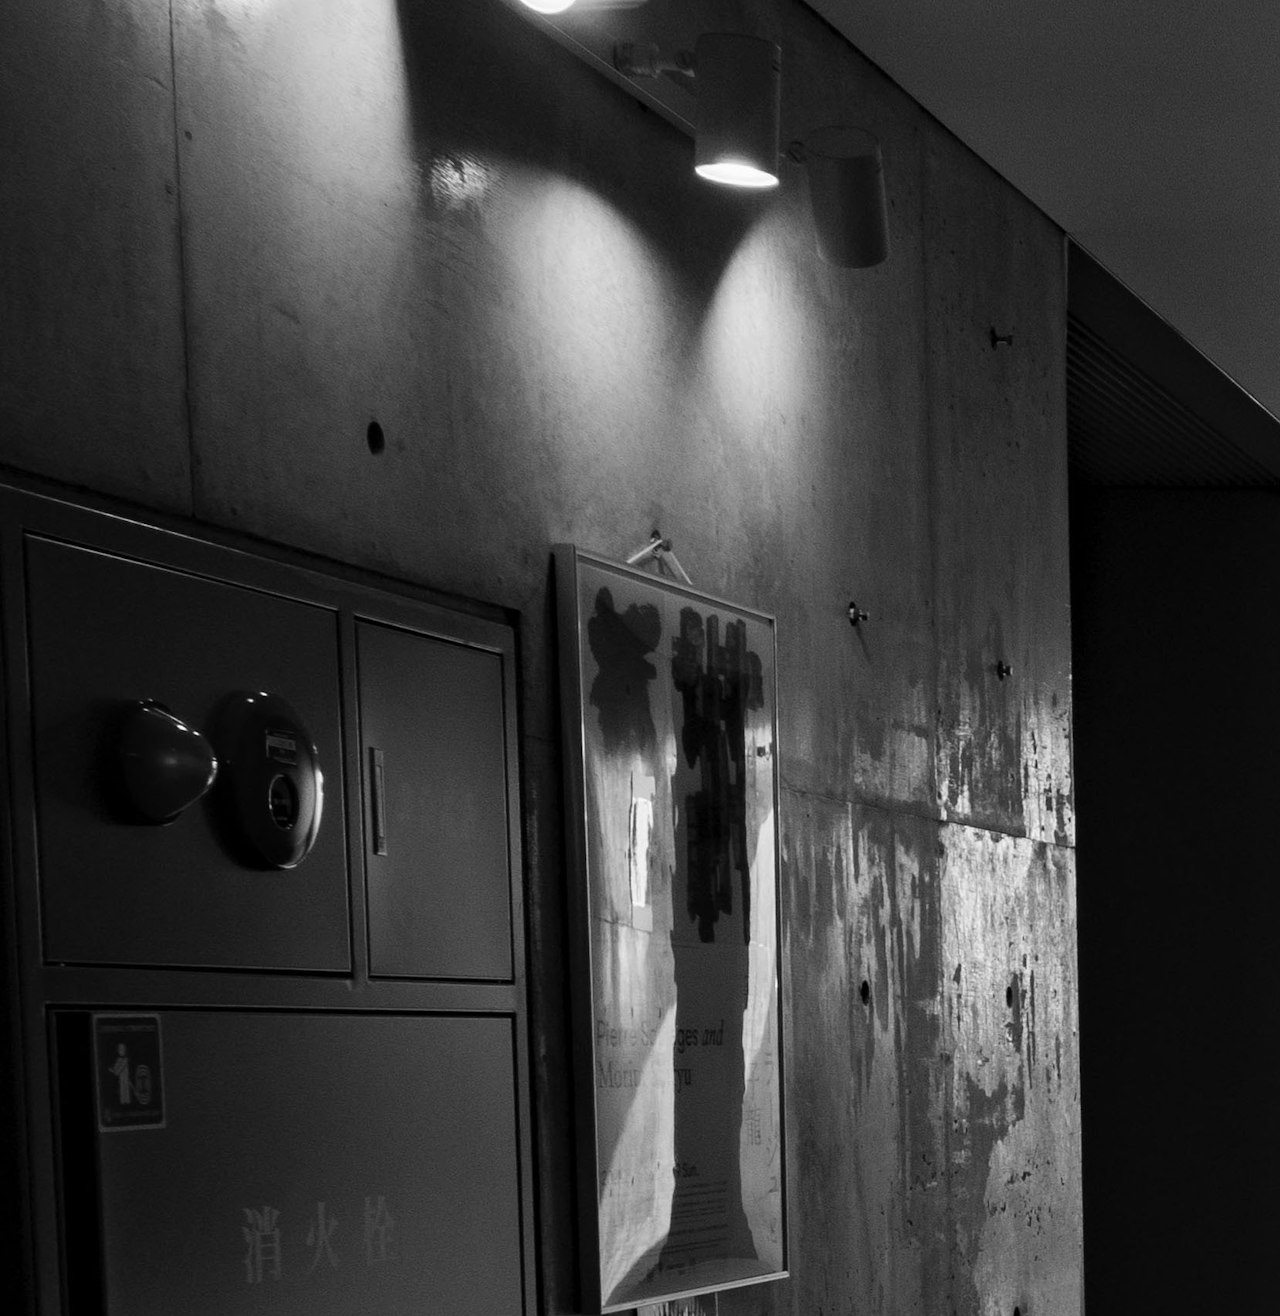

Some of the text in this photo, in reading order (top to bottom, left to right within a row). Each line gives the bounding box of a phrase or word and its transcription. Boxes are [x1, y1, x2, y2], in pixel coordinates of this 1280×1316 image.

[702, 1019, 724, 1046] and
[241, 1194, 400, 1285] 消火栓
